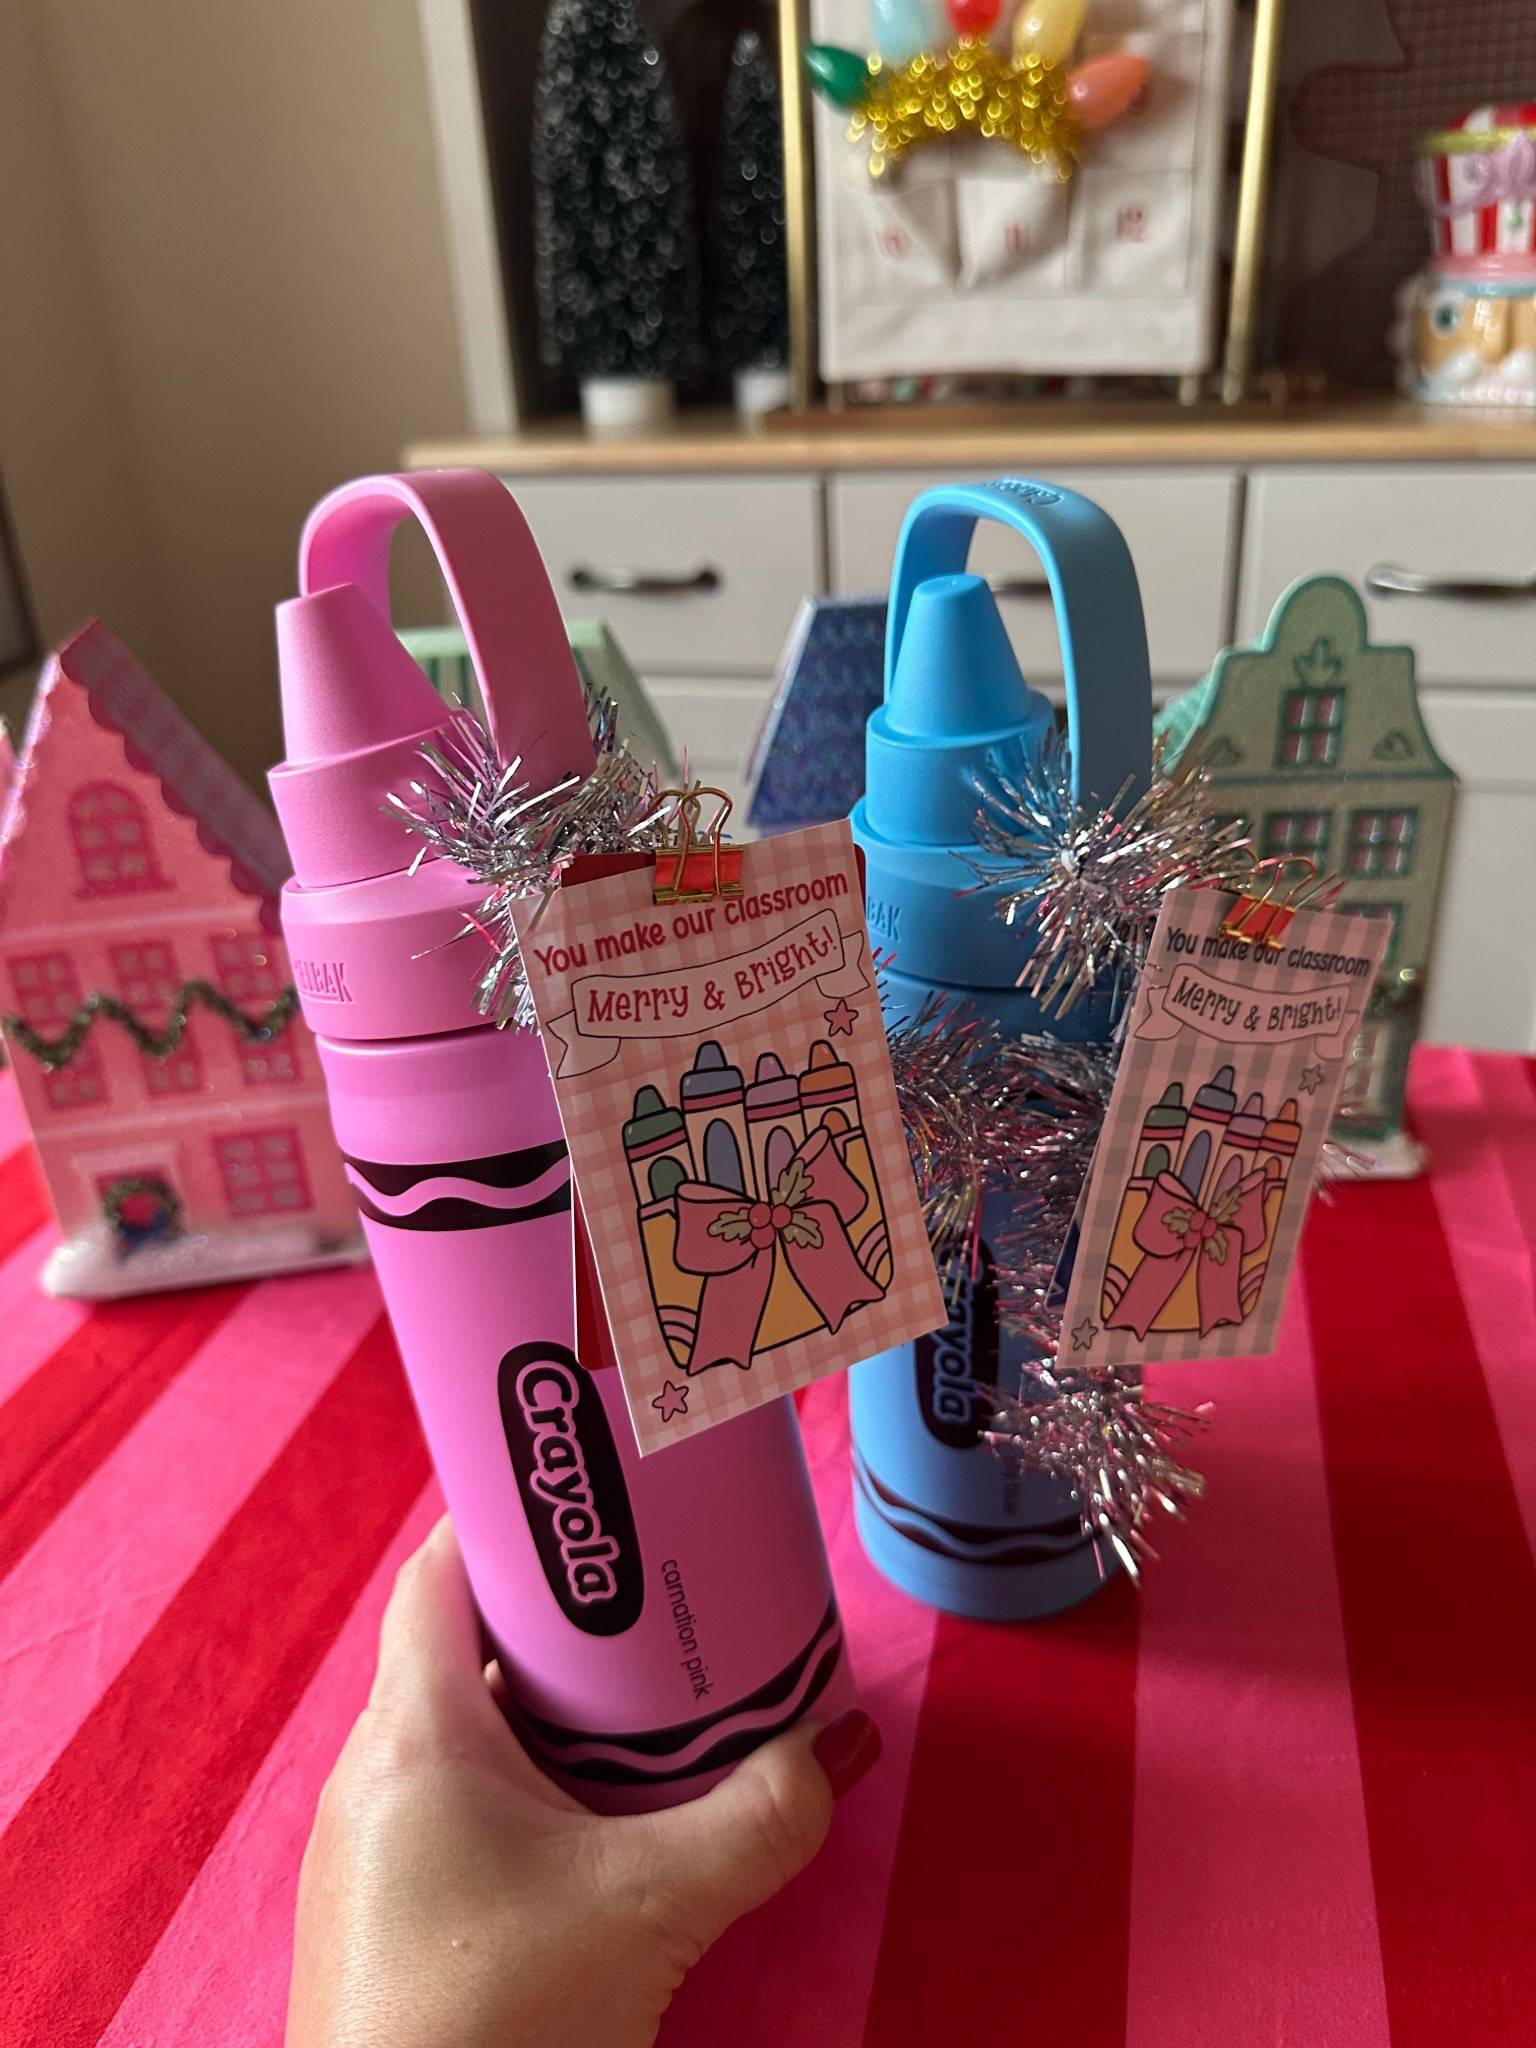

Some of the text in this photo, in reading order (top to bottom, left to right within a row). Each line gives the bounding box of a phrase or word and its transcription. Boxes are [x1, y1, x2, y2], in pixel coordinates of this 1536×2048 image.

[533, 944, 587, 977] You
[594, 922, 666, 962] make
[672, 907, 716, 940] our
[724, 872, 848, 923] classroom
[587, 926, 838, 1023] Merry & Bright!
[1166, 926, 1371, 978] You make our classroom
[1171, 976, 1342, 1031] Merry & Bright!
[516, 1360, 620, 1604] Crayola
[661, 1559, 714, 1700] carnation pink
